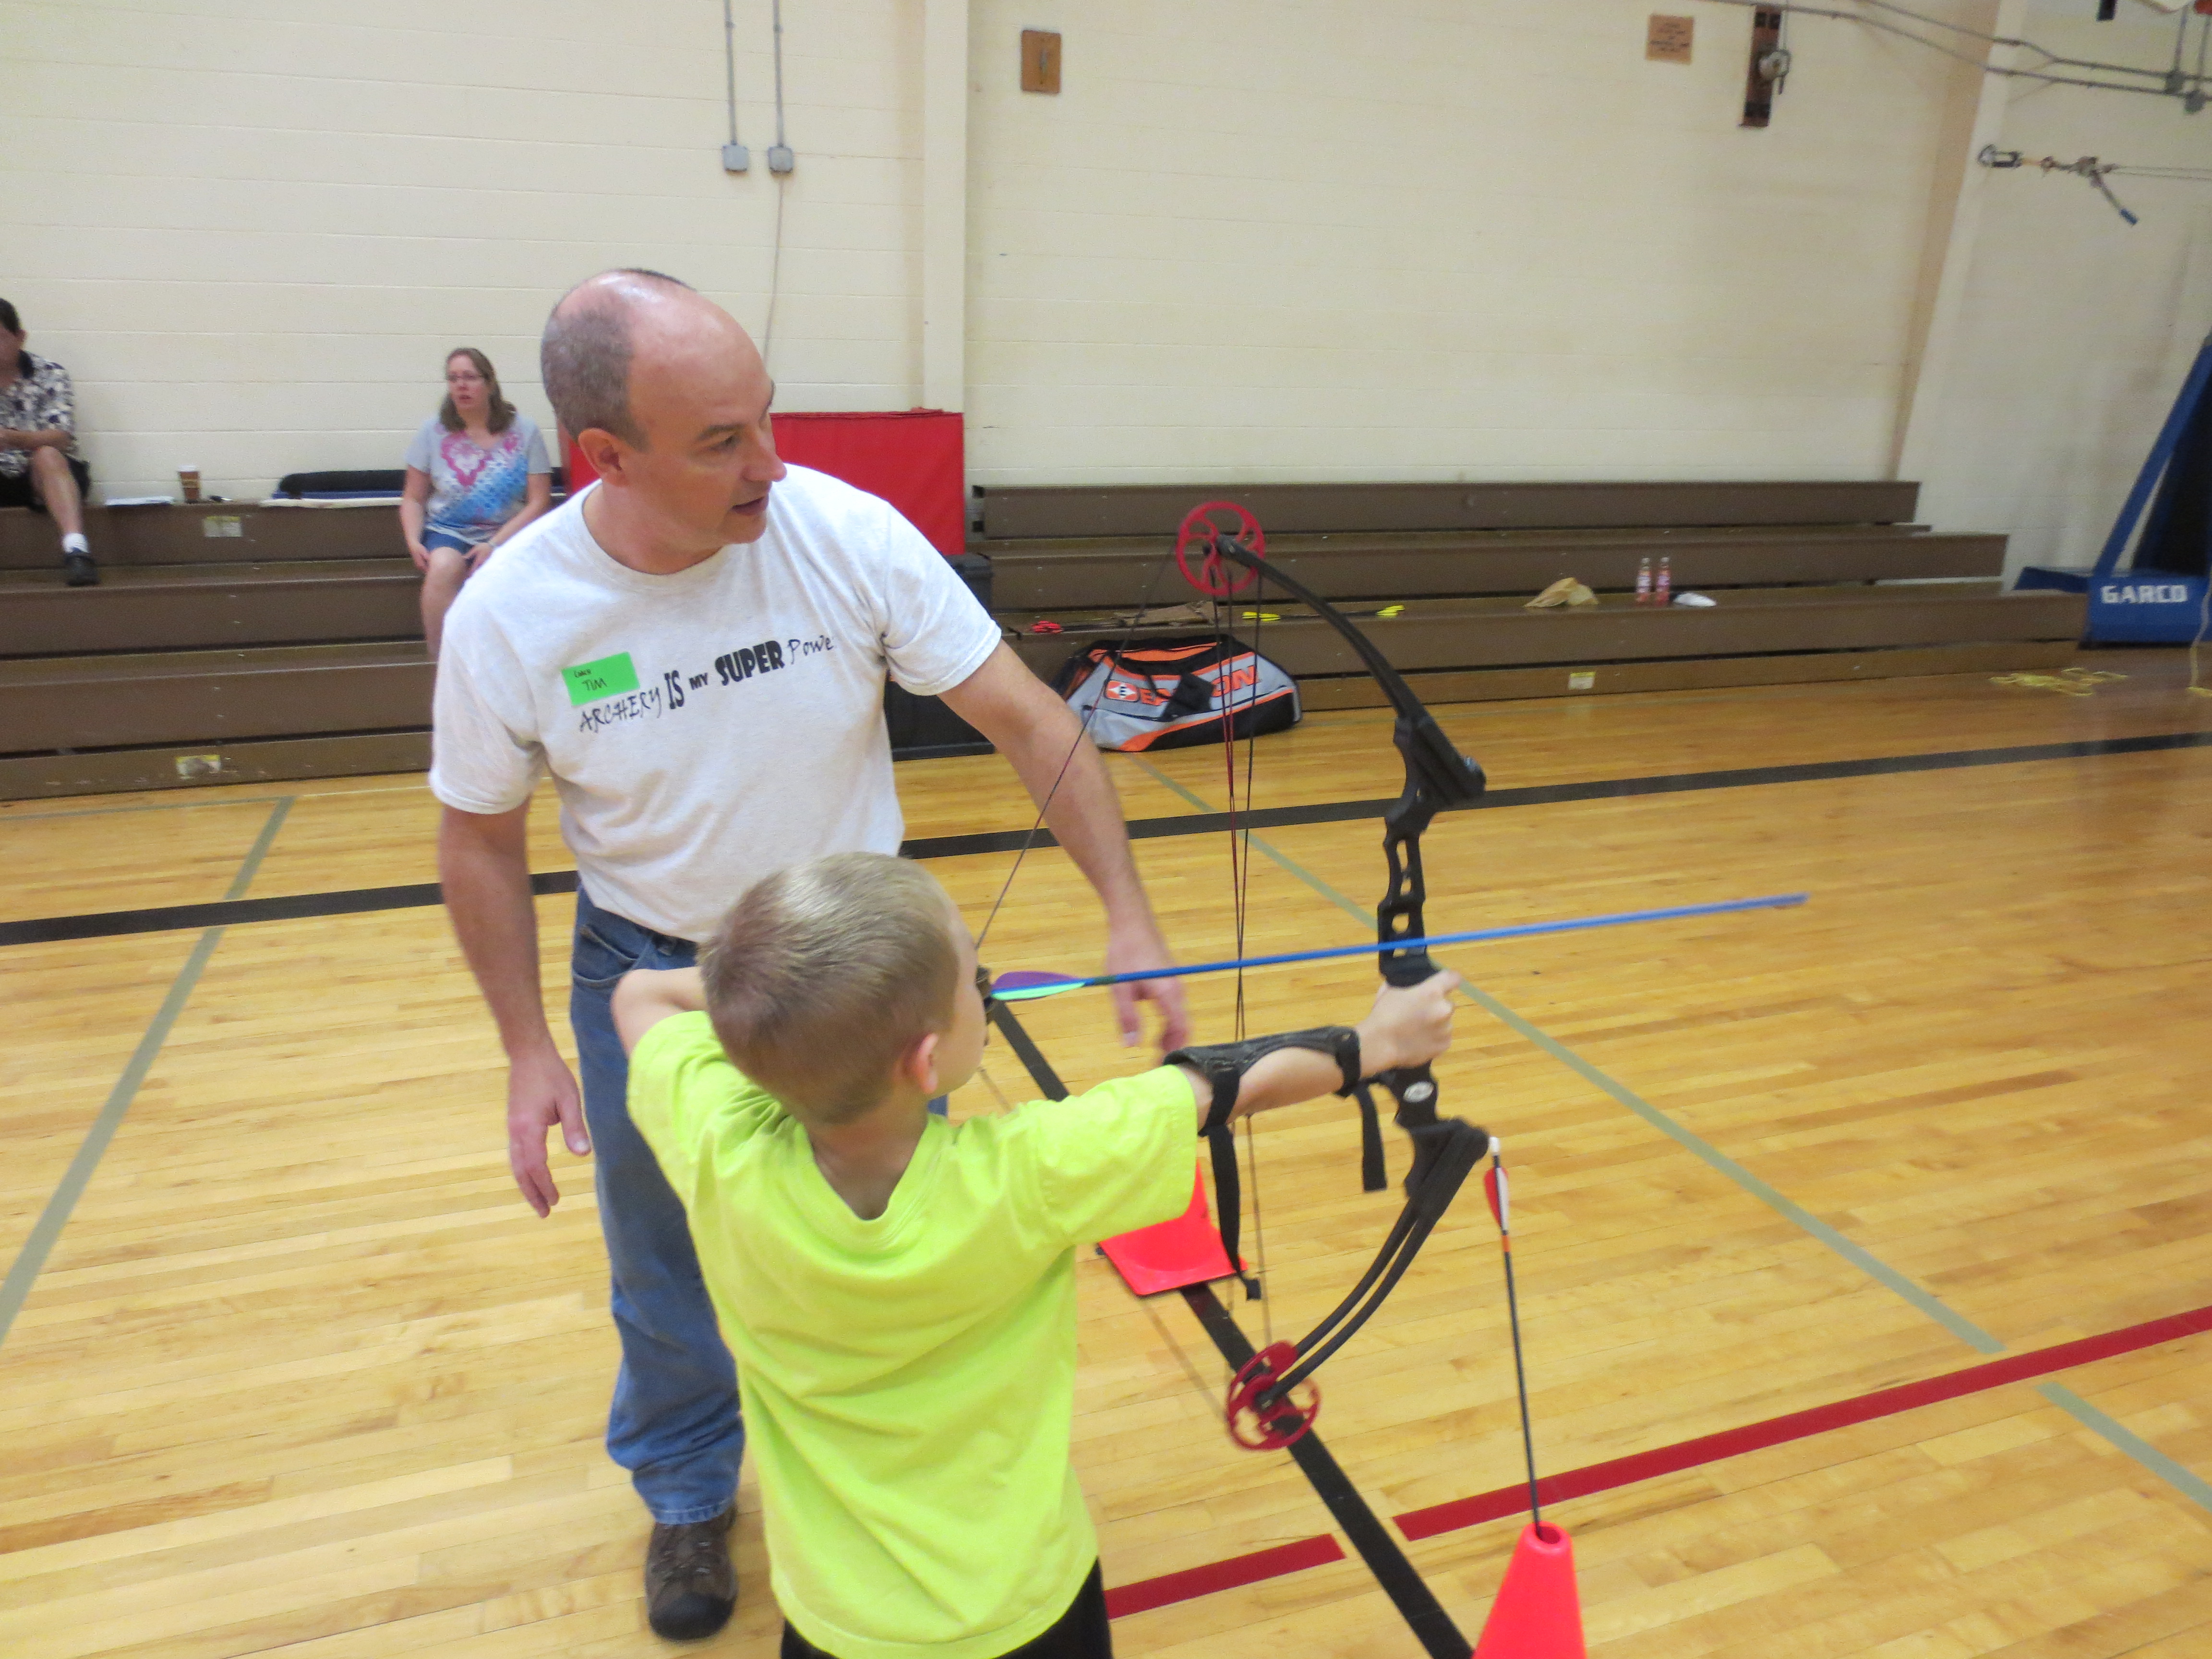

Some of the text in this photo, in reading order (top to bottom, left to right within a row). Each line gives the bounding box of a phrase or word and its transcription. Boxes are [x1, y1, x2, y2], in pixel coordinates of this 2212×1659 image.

[579, 686, 661, 733] ARCHERY
[664, 670, 684, 709] IS
[688, 672, 709, 690] MY
[715, 640, 785, 686] SUPER
